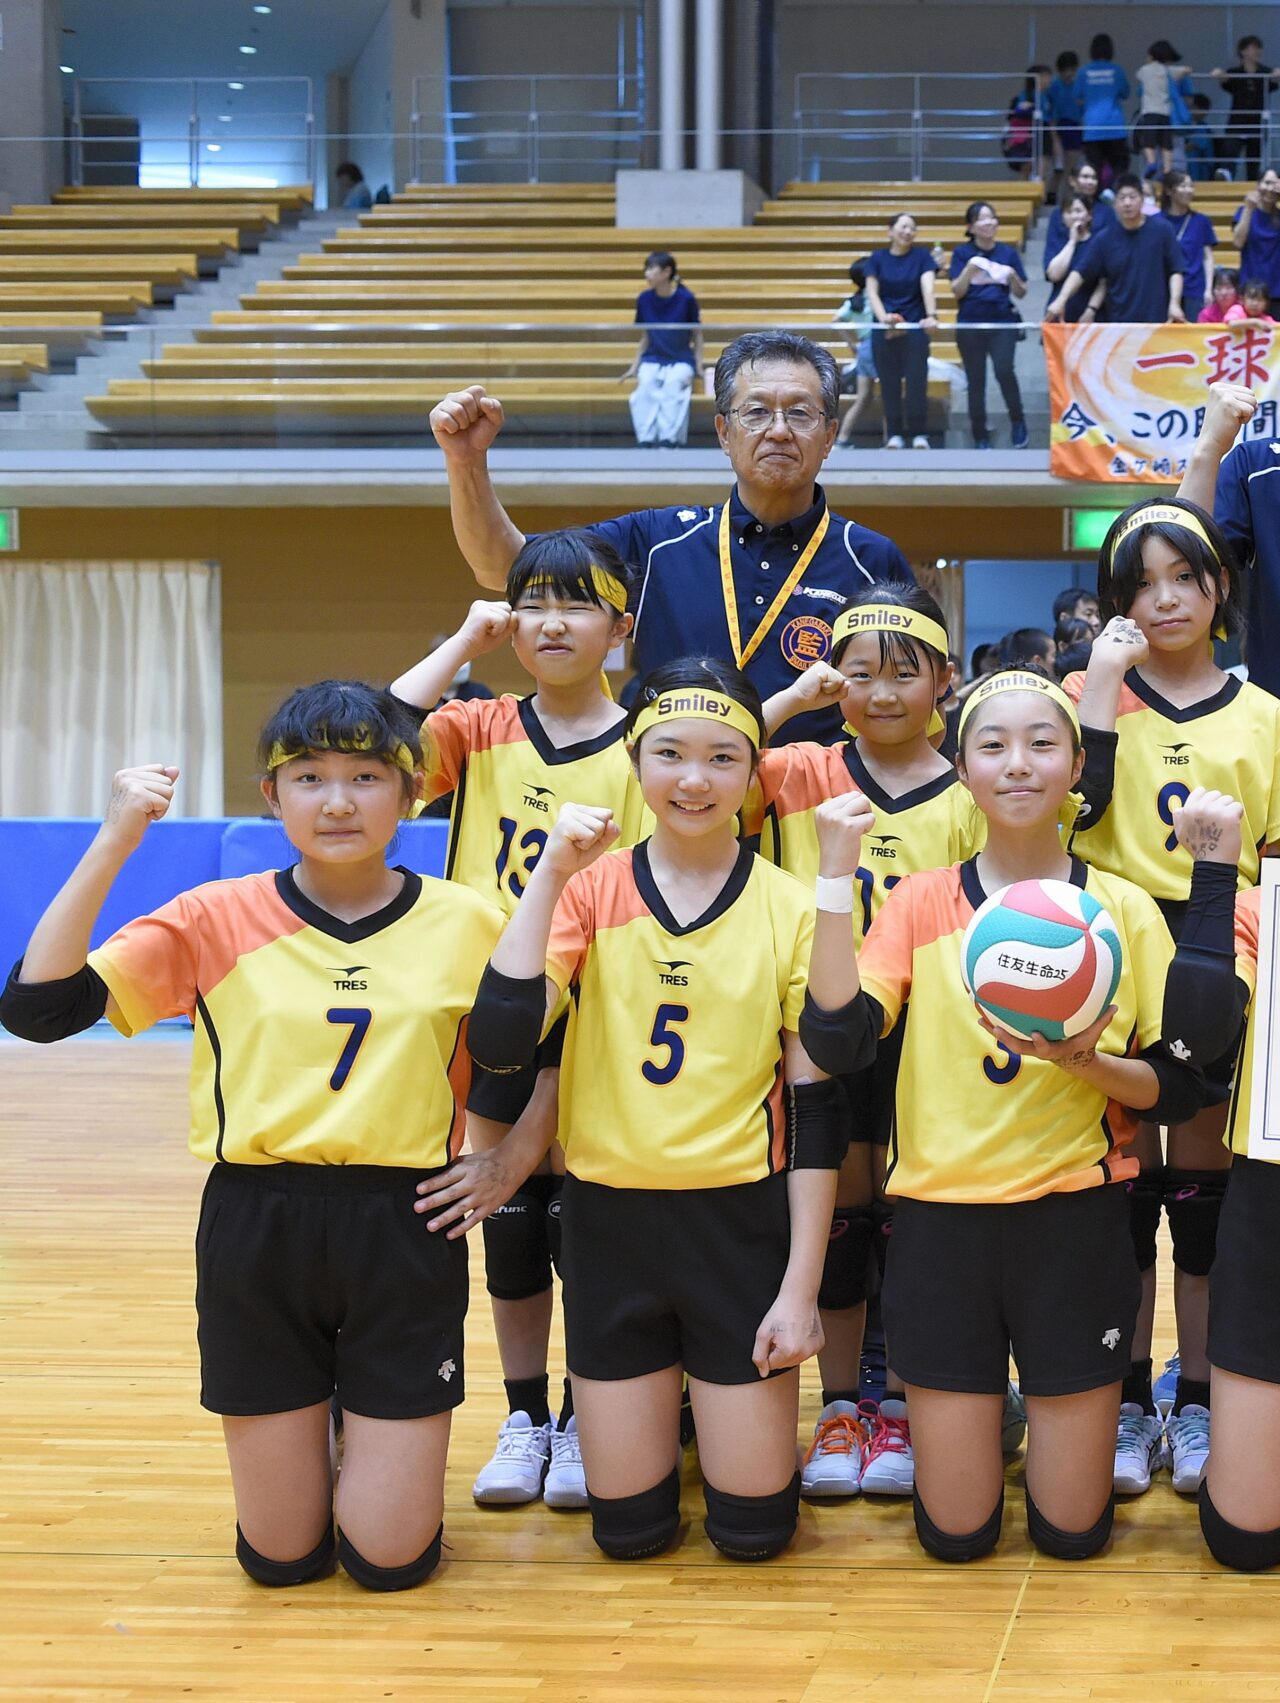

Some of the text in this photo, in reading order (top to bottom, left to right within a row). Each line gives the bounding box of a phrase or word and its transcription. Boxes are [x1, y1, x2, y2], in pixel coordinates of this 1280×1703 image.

[847, 609, 914, 629] Smiley
[979, 671, 1050, 698] Smiley
[657, 694, 731, 718] Smiley
[1163, 755, 1190, 765] TRES
[522, 795, 549, 813] TRES
[495, 816, 549, 899] 13
[869, 847, 897, 859] TRES
[997, 953, 1070, 981] 住友生命25
[333, 980, 368, 991] TRES
[659, 973, 689, 986] TRES
[325, 1006, 373, 1092] 7
[641, 1003, 690, 1086] 5
